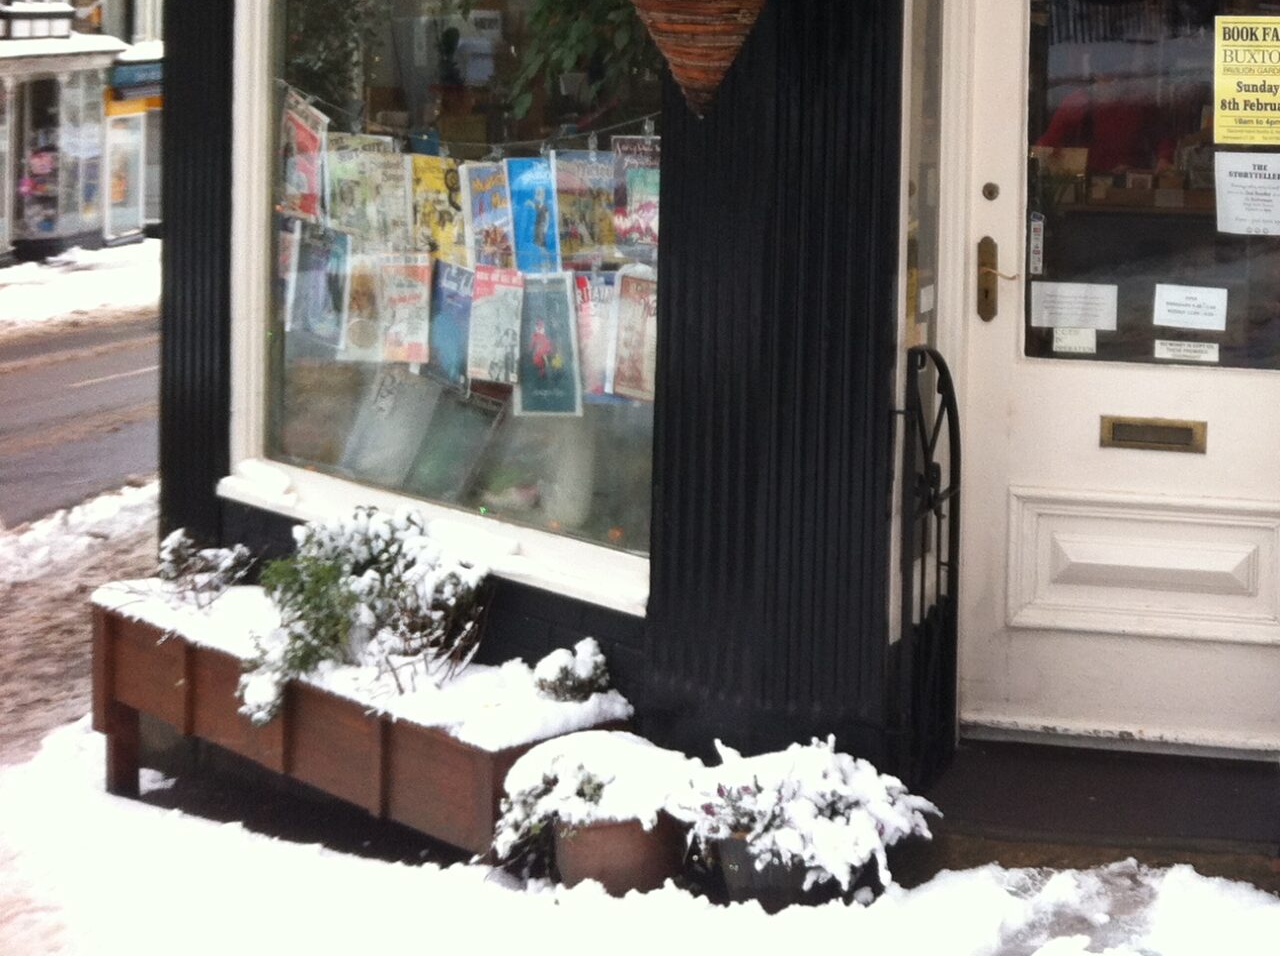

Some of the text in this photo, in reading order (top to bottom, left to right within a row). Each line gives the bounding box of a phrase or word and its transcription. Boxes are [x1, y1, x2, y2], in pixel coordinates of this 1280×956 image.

[1222, 26, 1260, 42] BOOK
[1236, 80, 1280, 96] Sunday
[1220, 98, 1240, 111] 8th
